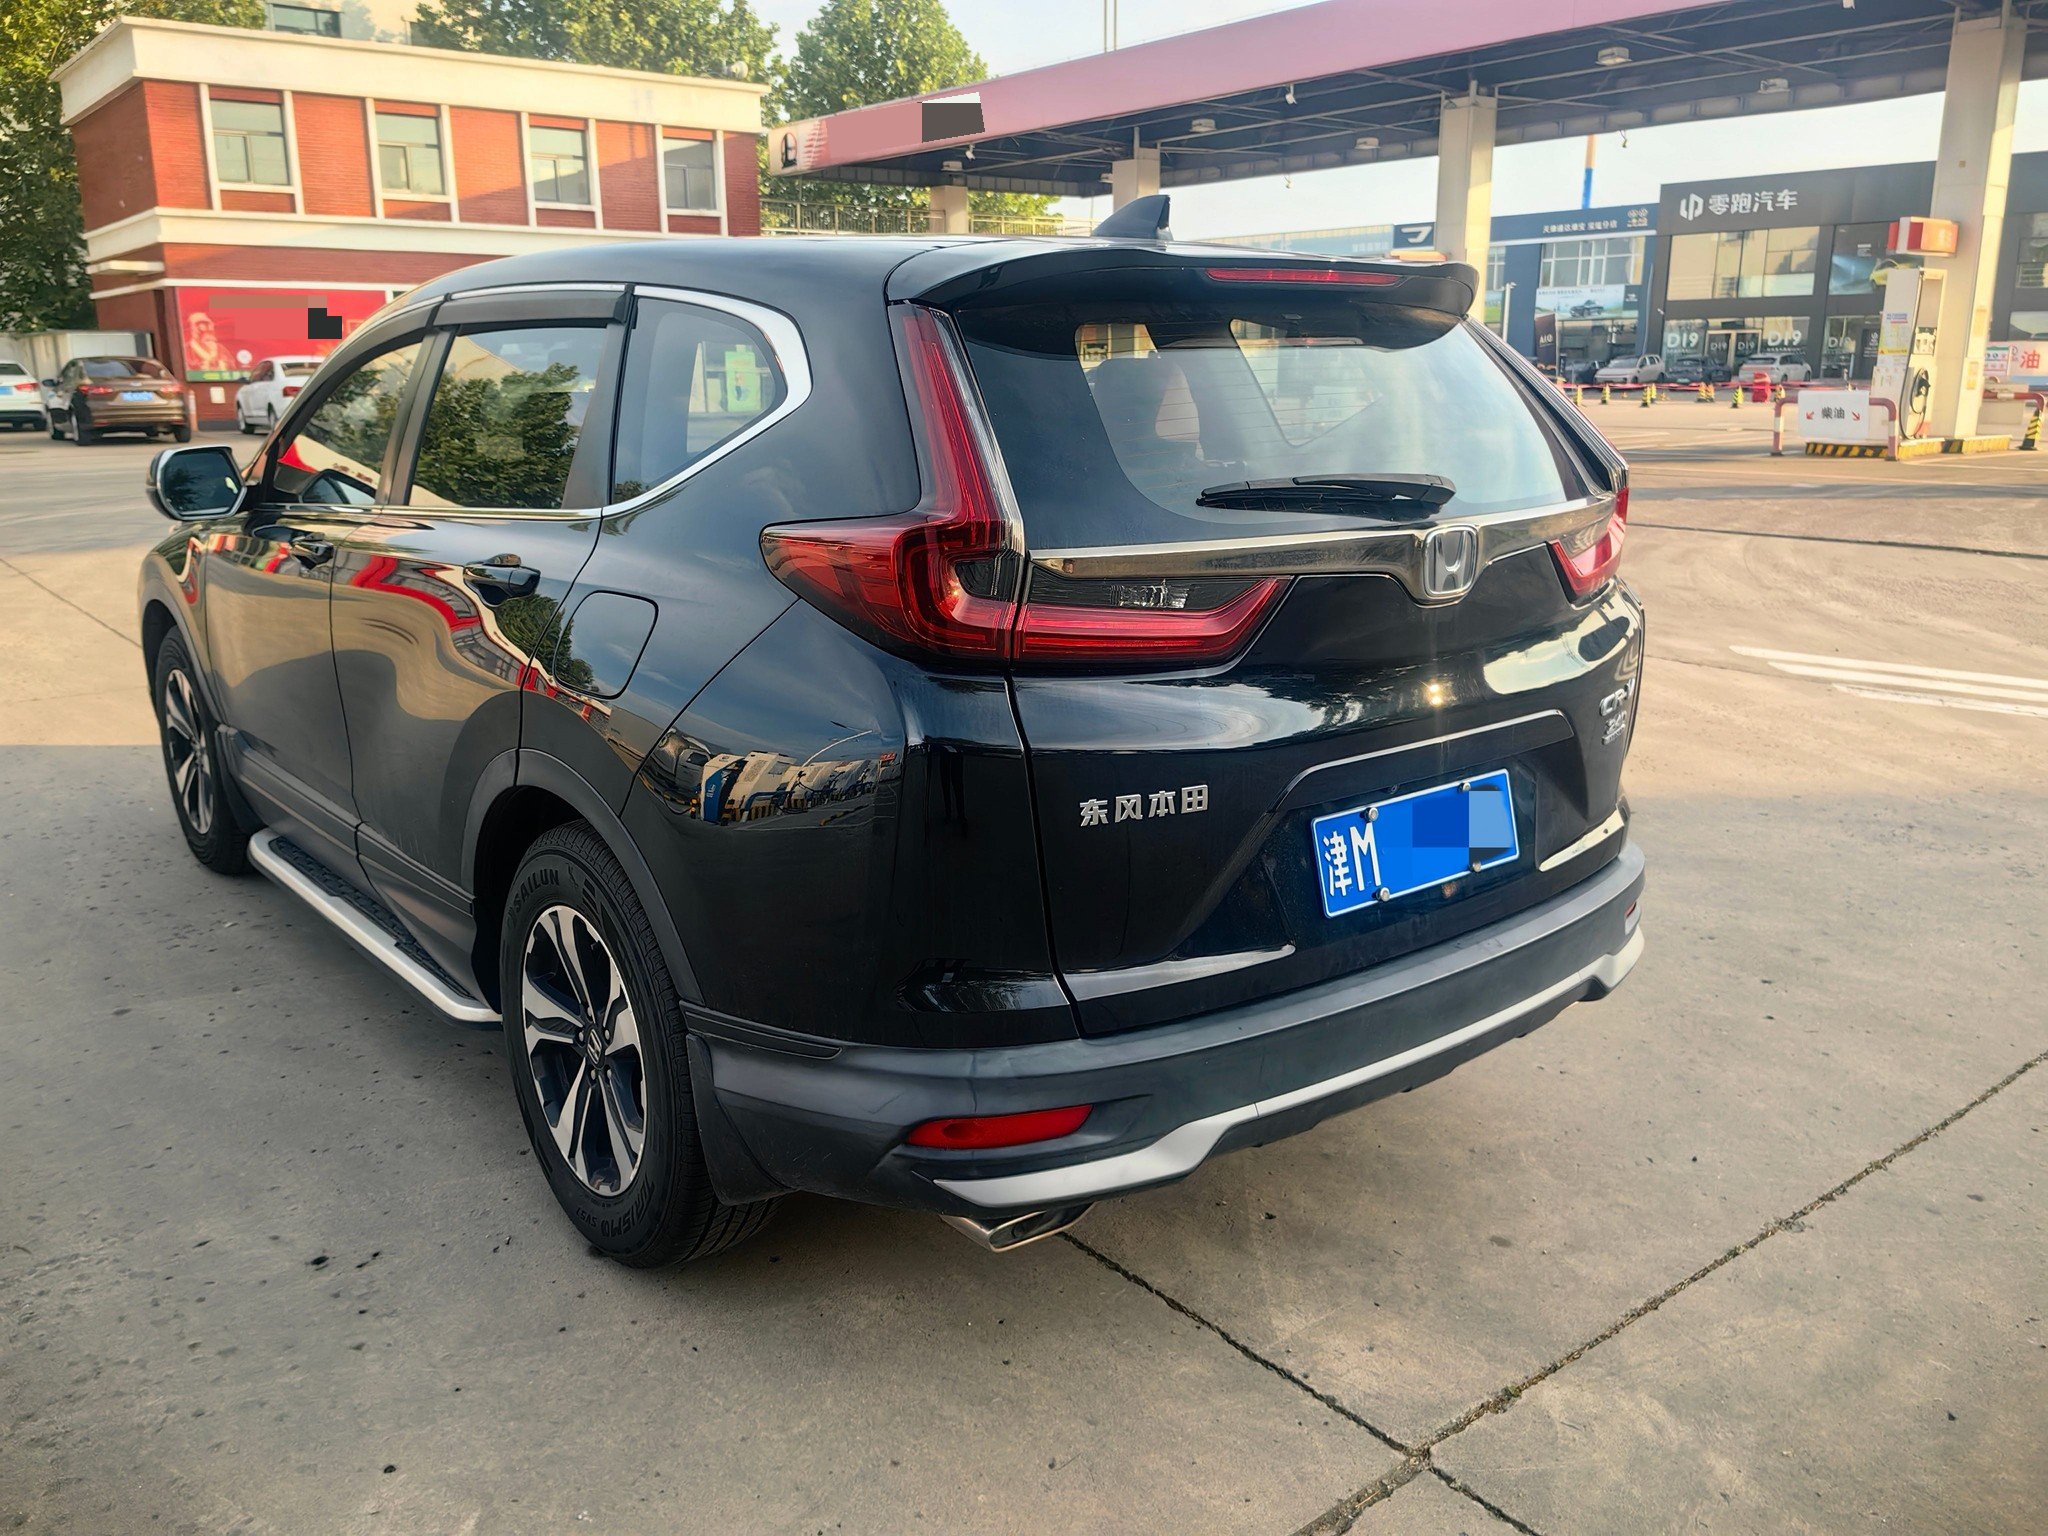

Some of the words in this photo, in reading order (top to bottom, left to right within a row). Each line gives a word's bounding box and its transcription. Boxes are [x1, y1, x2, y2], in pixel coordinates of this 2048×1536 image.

[1708, 189, 1798, 215] 零跑汽车
[2020, 349, 2041, 369] 油
[1821, 406, 1845, 419] 柴油
[1079, 784, 1208, 827] 东风本田
[513, 868, 560, 913] SAILUN
